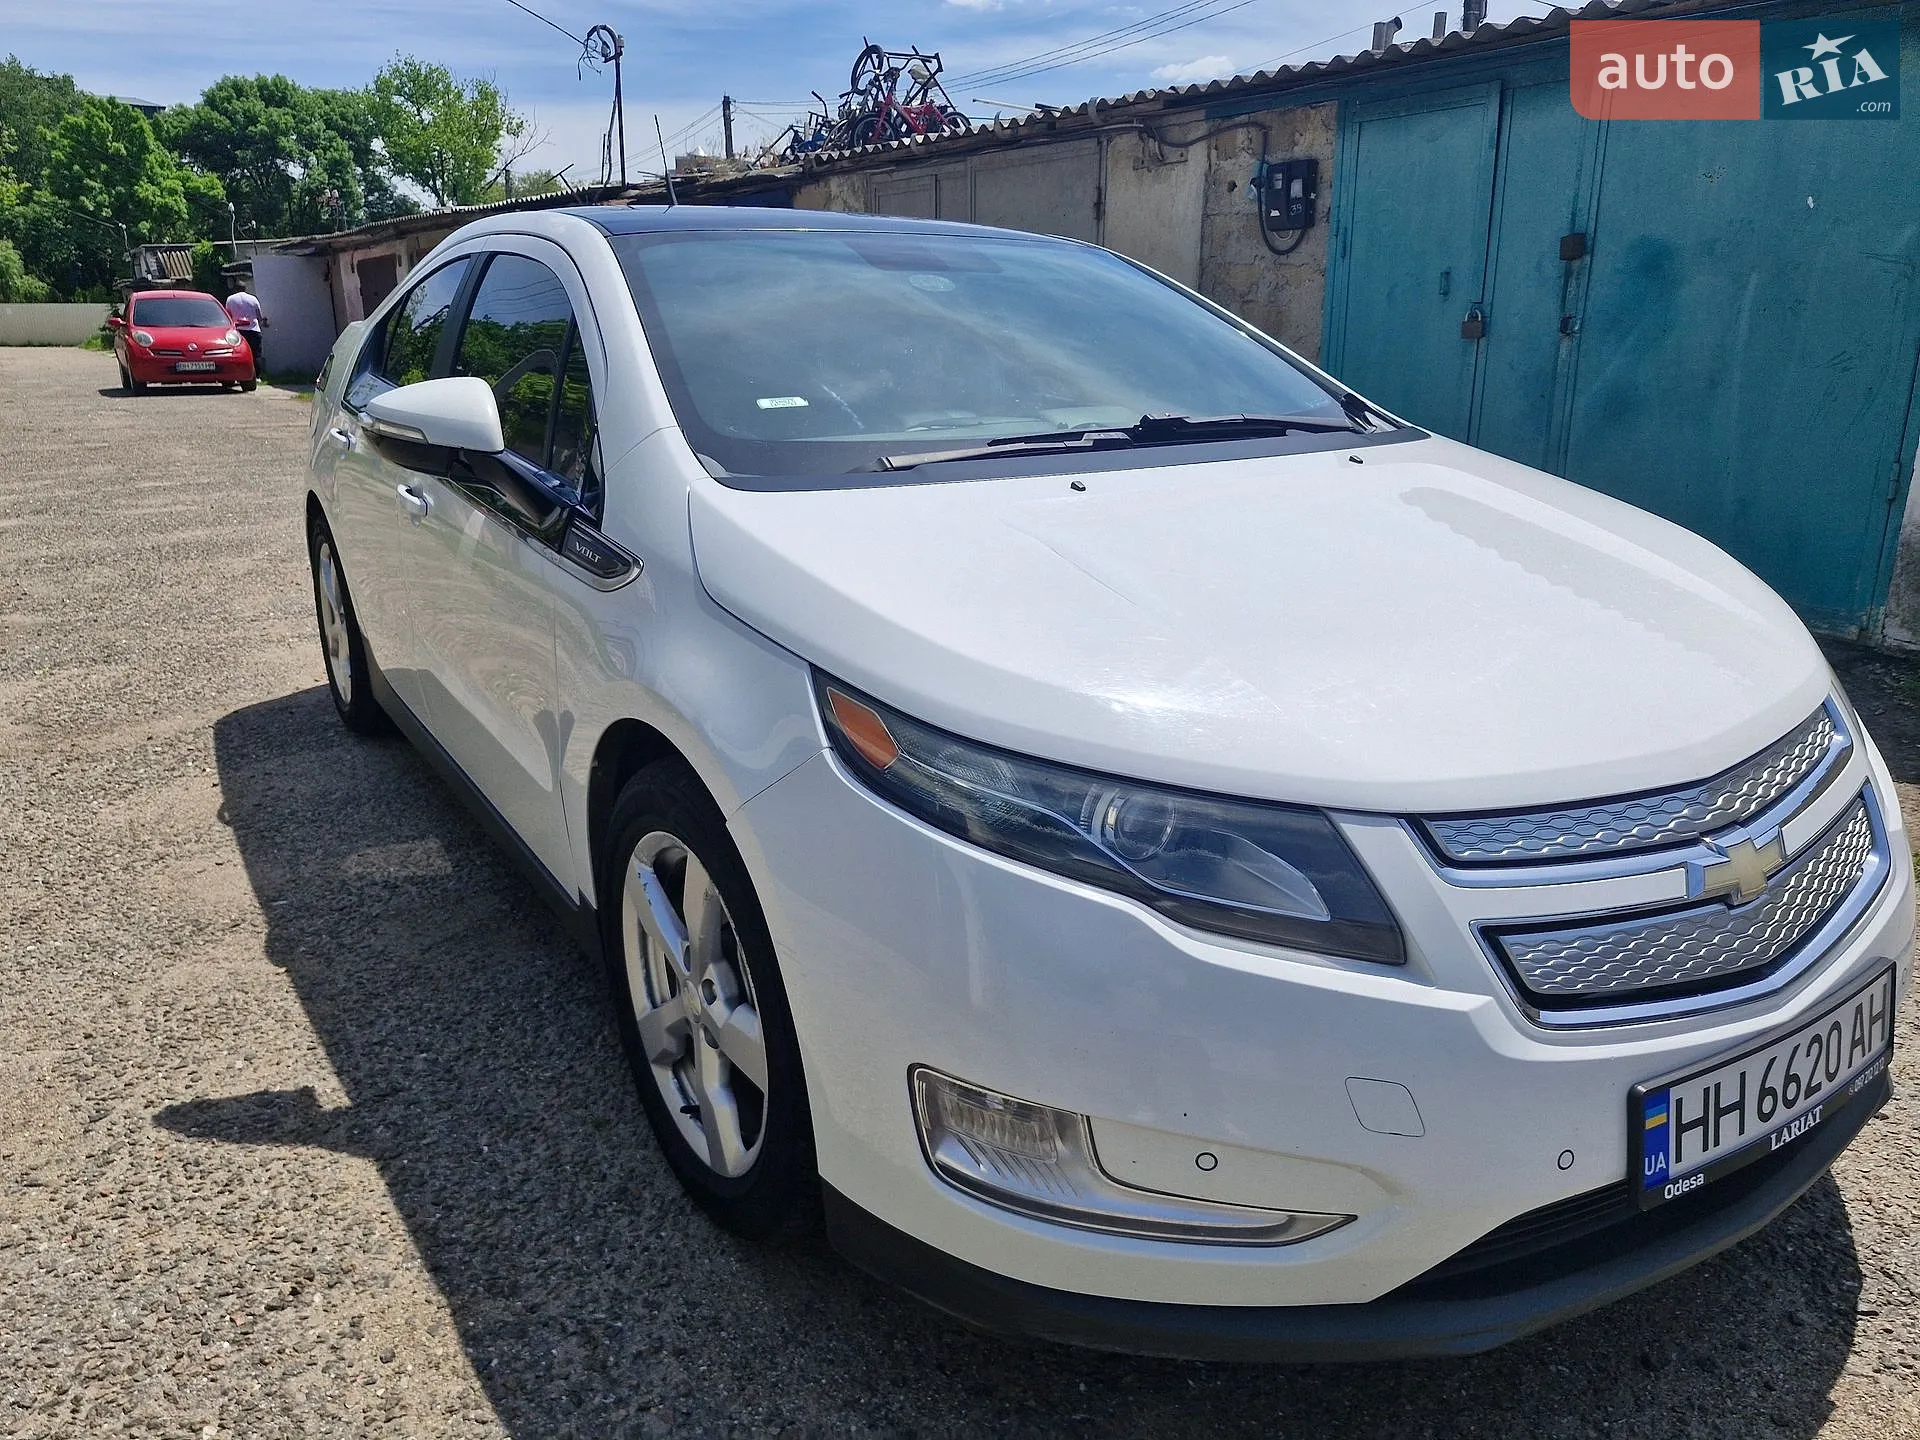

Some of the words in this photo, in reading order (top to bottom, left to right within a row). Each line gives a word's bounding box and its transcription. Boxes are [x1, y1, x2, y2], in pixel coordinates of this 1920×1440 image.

[576, 541, 601, 563] VOLT
[1770, 1105, 1823, 1150] LARIAT
[1644, 1151, 1667, 1176] UA
[1664, 1173, 1704, 1199] Odesa
